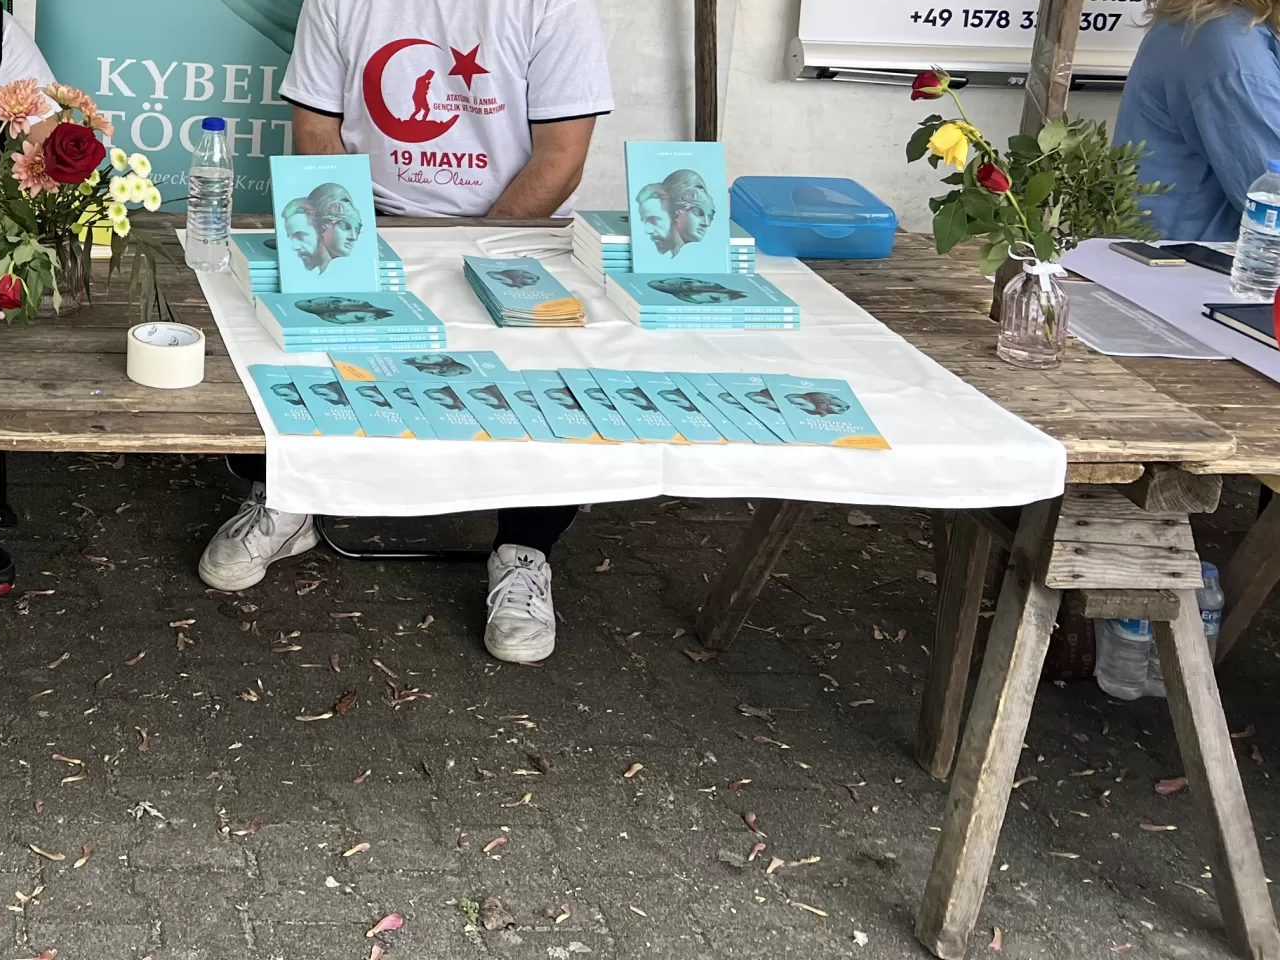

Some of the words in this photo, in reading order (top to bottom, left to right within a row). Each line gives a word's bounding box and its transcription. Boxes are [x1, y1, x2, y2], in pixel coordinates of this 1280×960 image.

[909, 8, 953, 27] +49
[961, 8, 1011, 29] 1578
[389, 149, 413, 166] 19
[420, 151, 488, 169] MAYIS
[396, 167, 433, 185] Kutlu
[433, 168, 484, 186] Olsun
